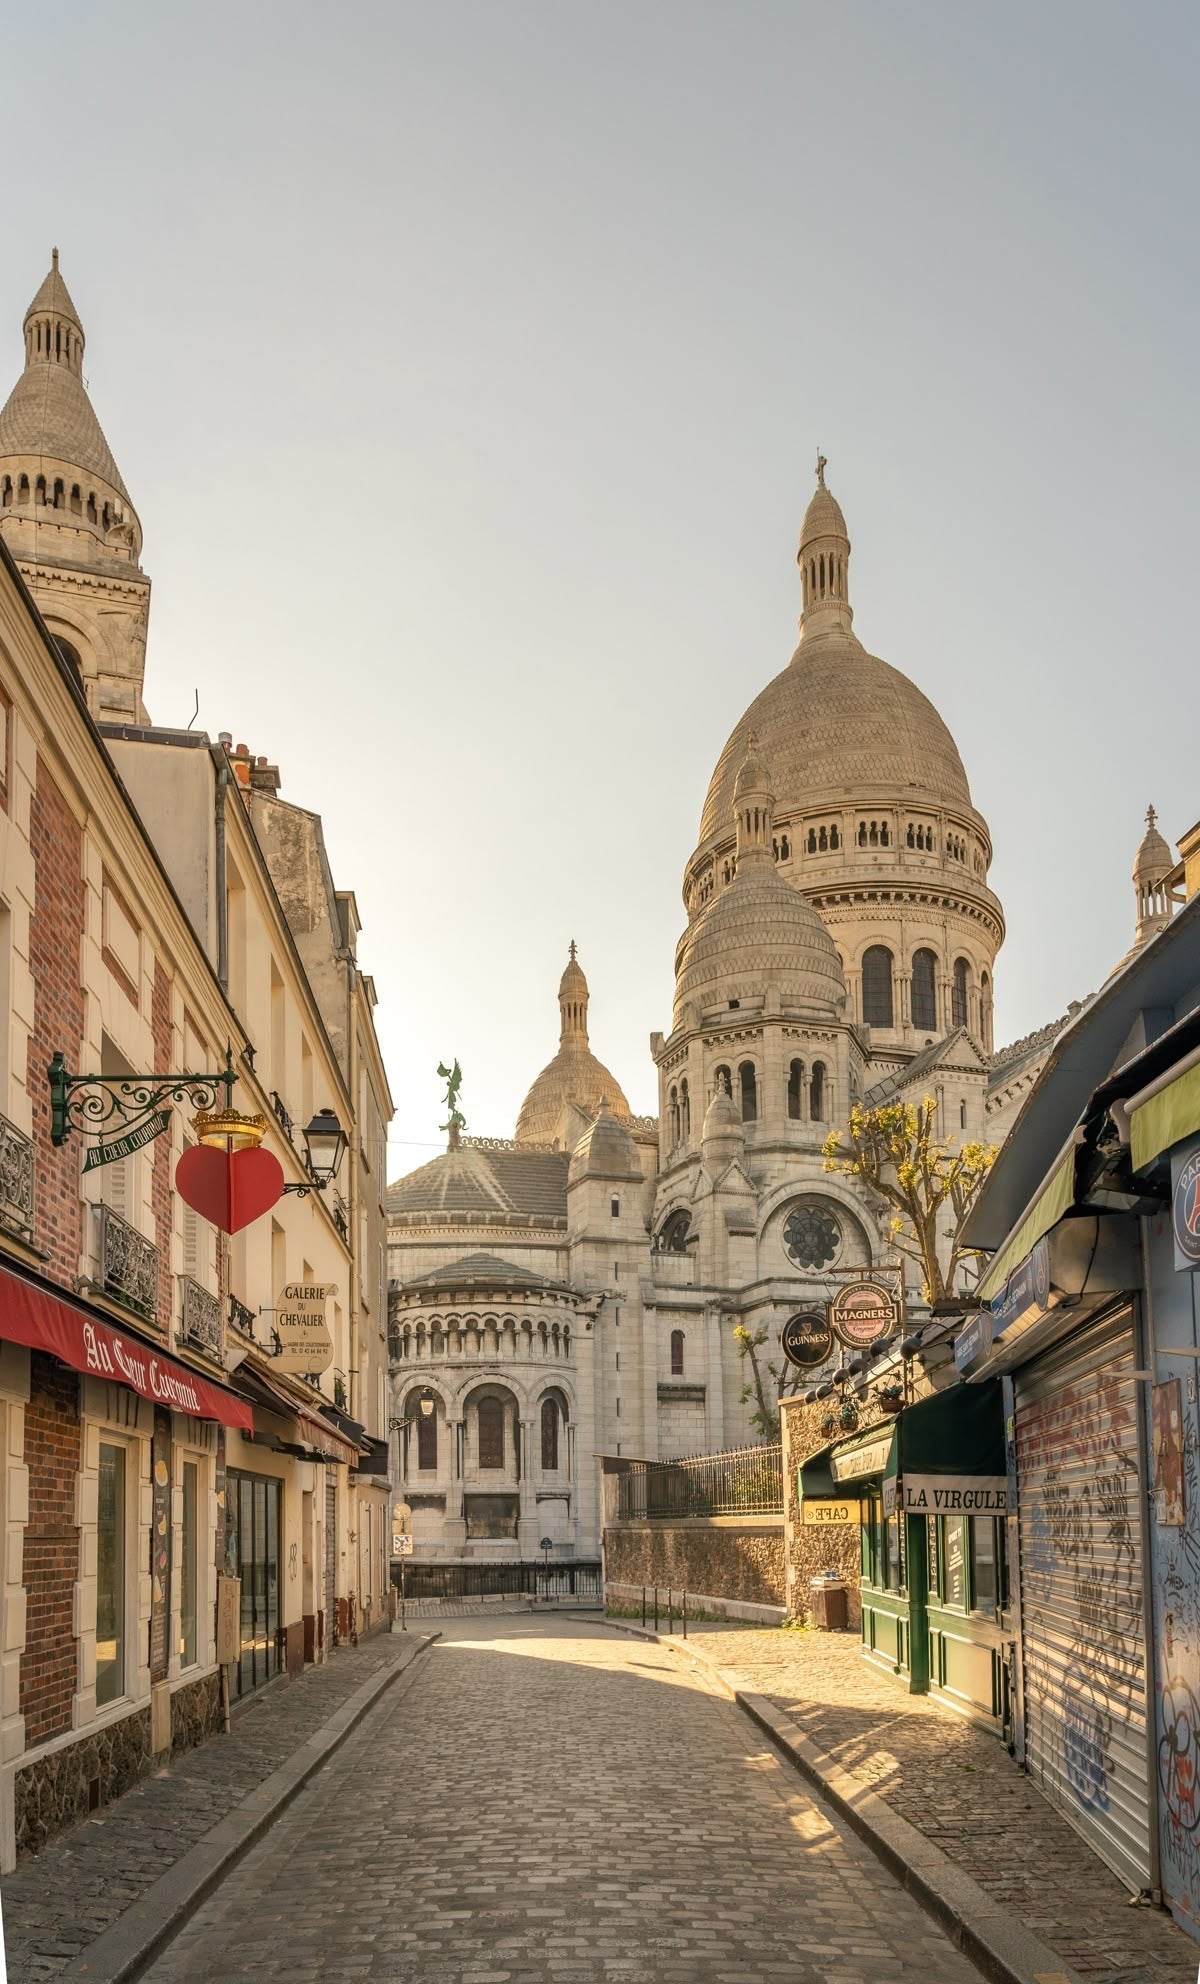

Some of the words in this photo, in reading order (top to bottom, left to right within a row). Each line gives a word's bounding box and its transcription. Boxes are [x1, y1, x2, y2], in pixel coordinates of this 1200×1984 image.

[89, 1149, 101, 1166] AU
[103, 1140, 130, 1162] COEUR
[285, 1287, 325, 1300] GALERIE
[298, 1302, 306, 1311] DU
[280, 1313, 323, 1327] CHEVALIER
[836, 1308, 893, 1321] MAGNERS
[788, 1330, 829, 1346] GUINNESS
[83, 1322, 114, 1373] Au
[906, 1488, 928, 1507] LA
[933, 1490, 1007, 1509] VIRGULE
